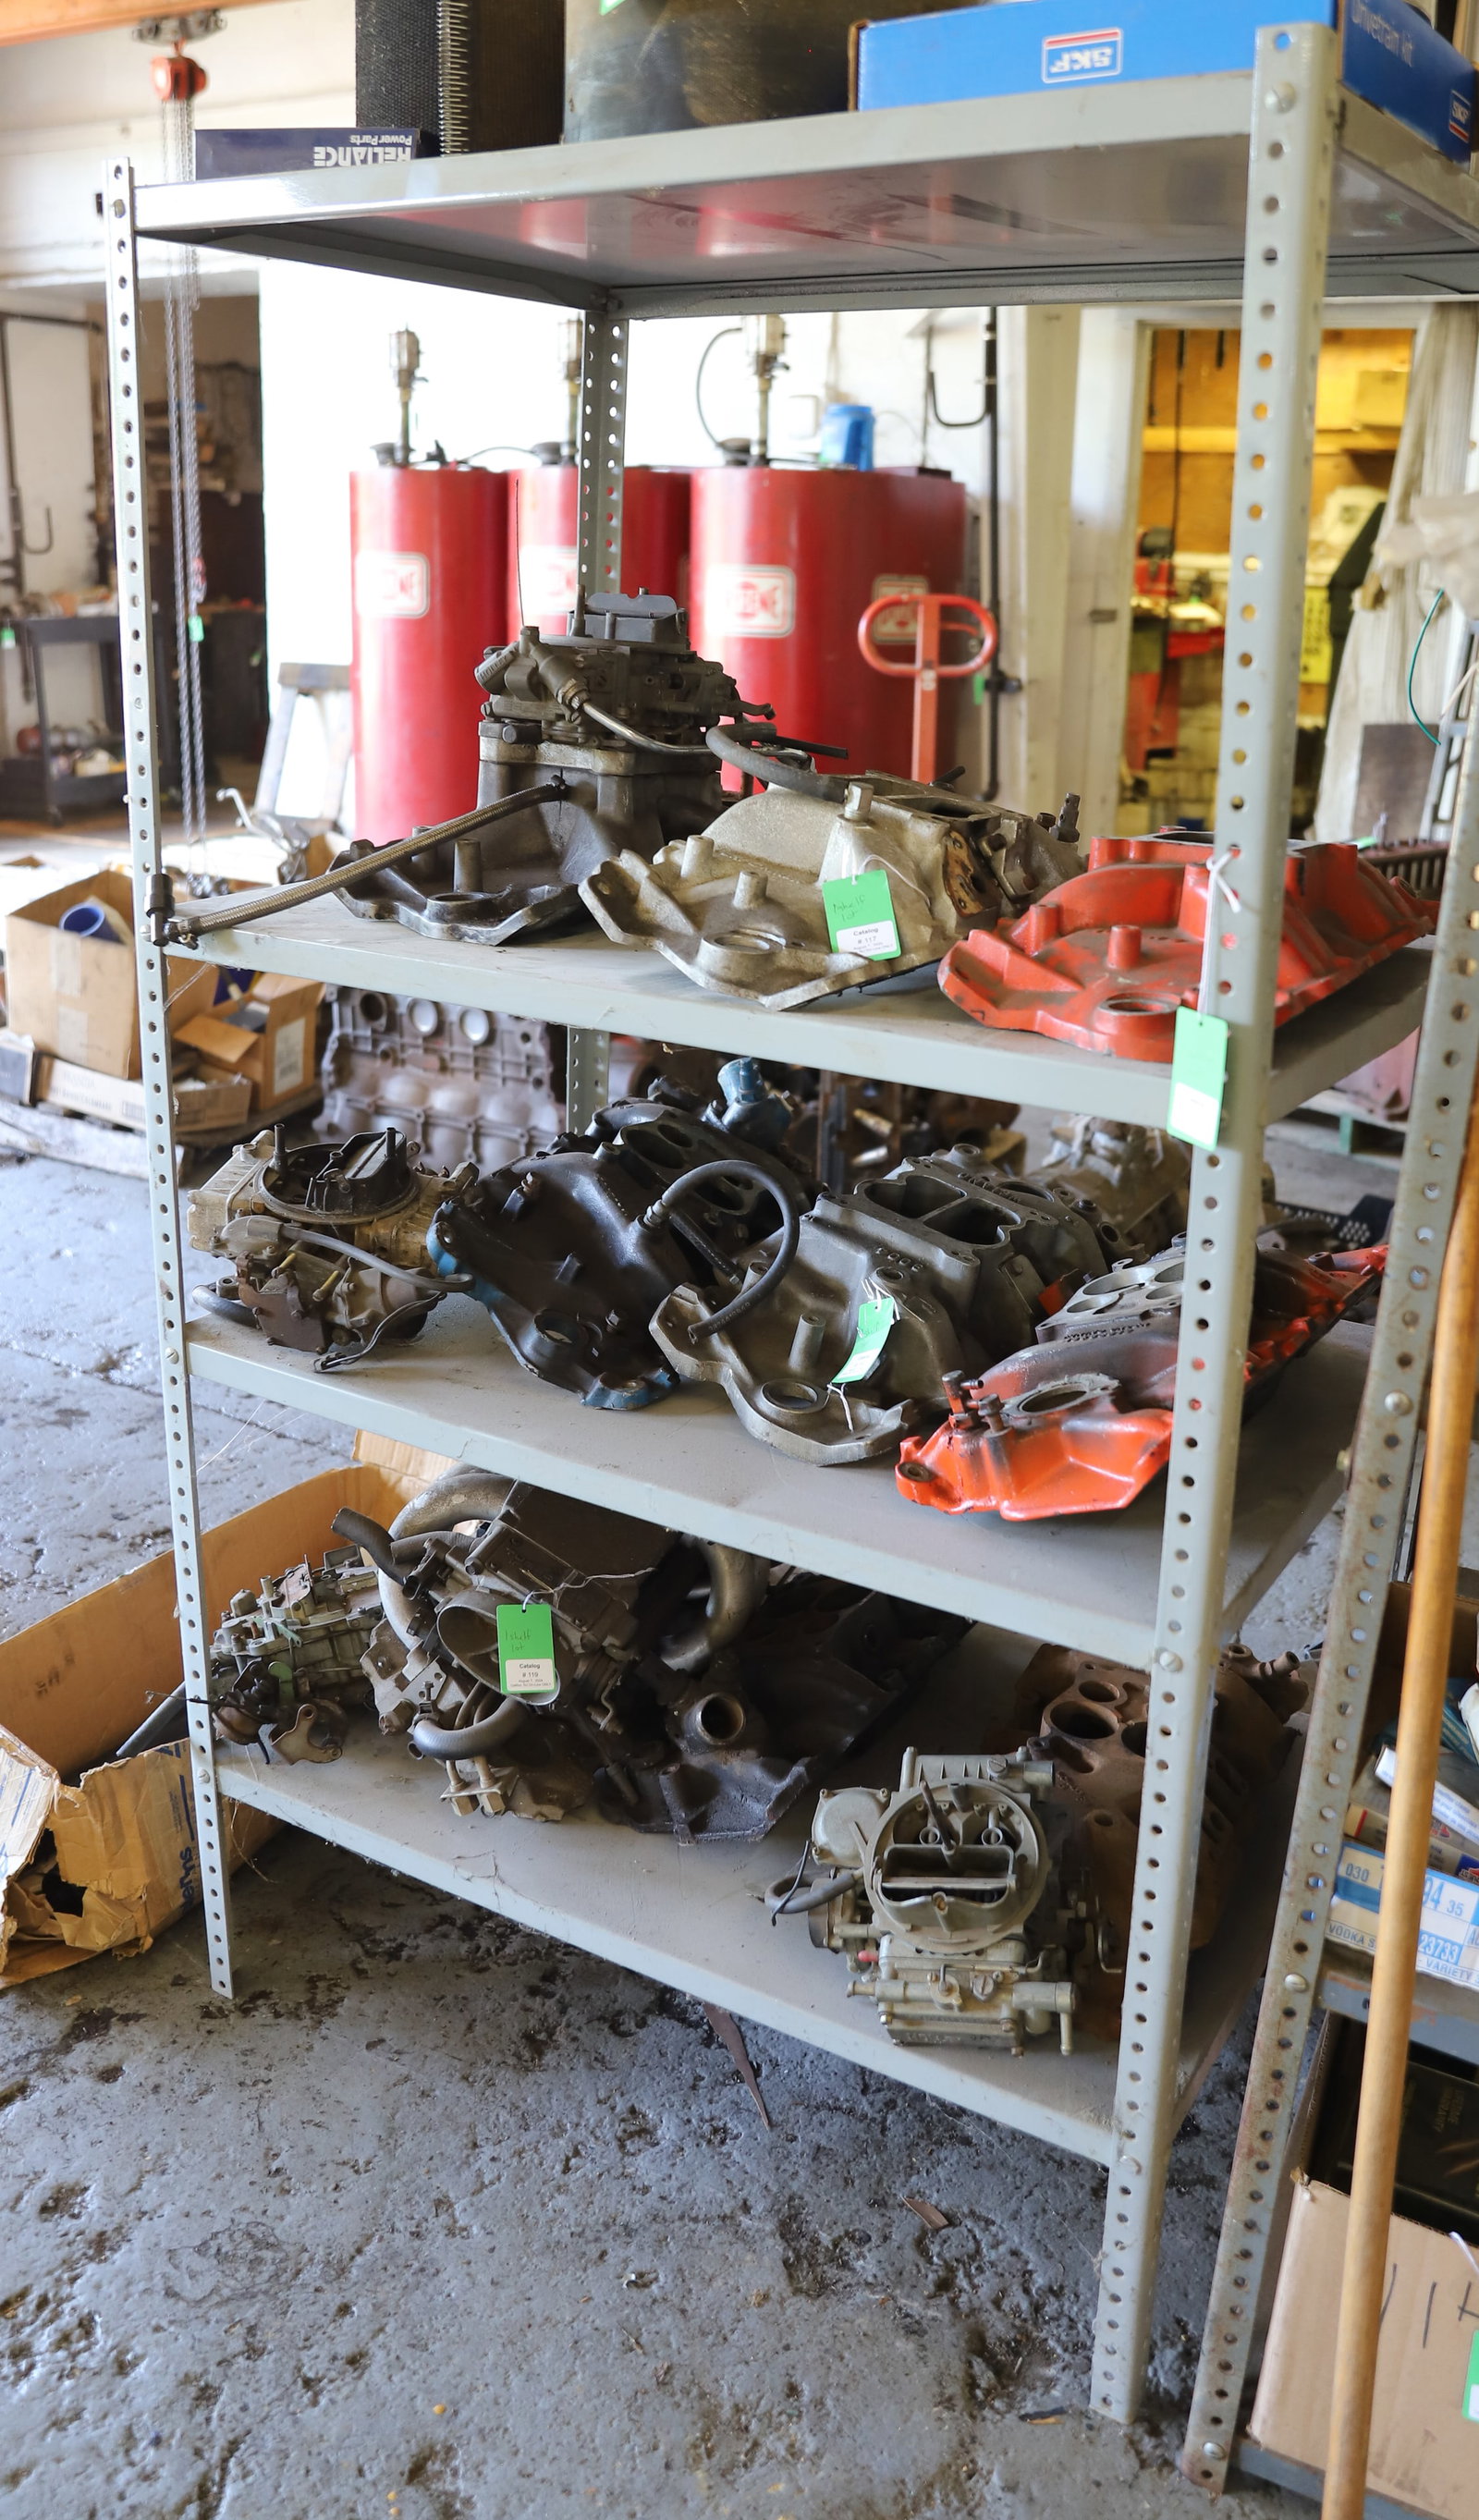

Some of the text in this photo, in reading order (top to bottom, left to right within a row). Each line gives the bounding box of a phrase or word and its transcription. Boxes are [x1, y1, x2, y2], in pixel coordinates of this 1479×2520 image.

[1048, 46, 1113, 73] SKF
[1451, 100, 1469, 124] SKF
[349, 134, 412, 146] Power Parts
[313, 146, 412, 166] RELIANCE
[852, 926, 879, 936] Catalog
[1345, 1863, 1370, 1882] 030
[1447, 1899, 1464, 1916] 35
[1328, 1924, 1364, 1945] VODKA
[1419, 1934, 1459, 1963] 23733
[1426, 1957, 1473, 1981] VARIETY
